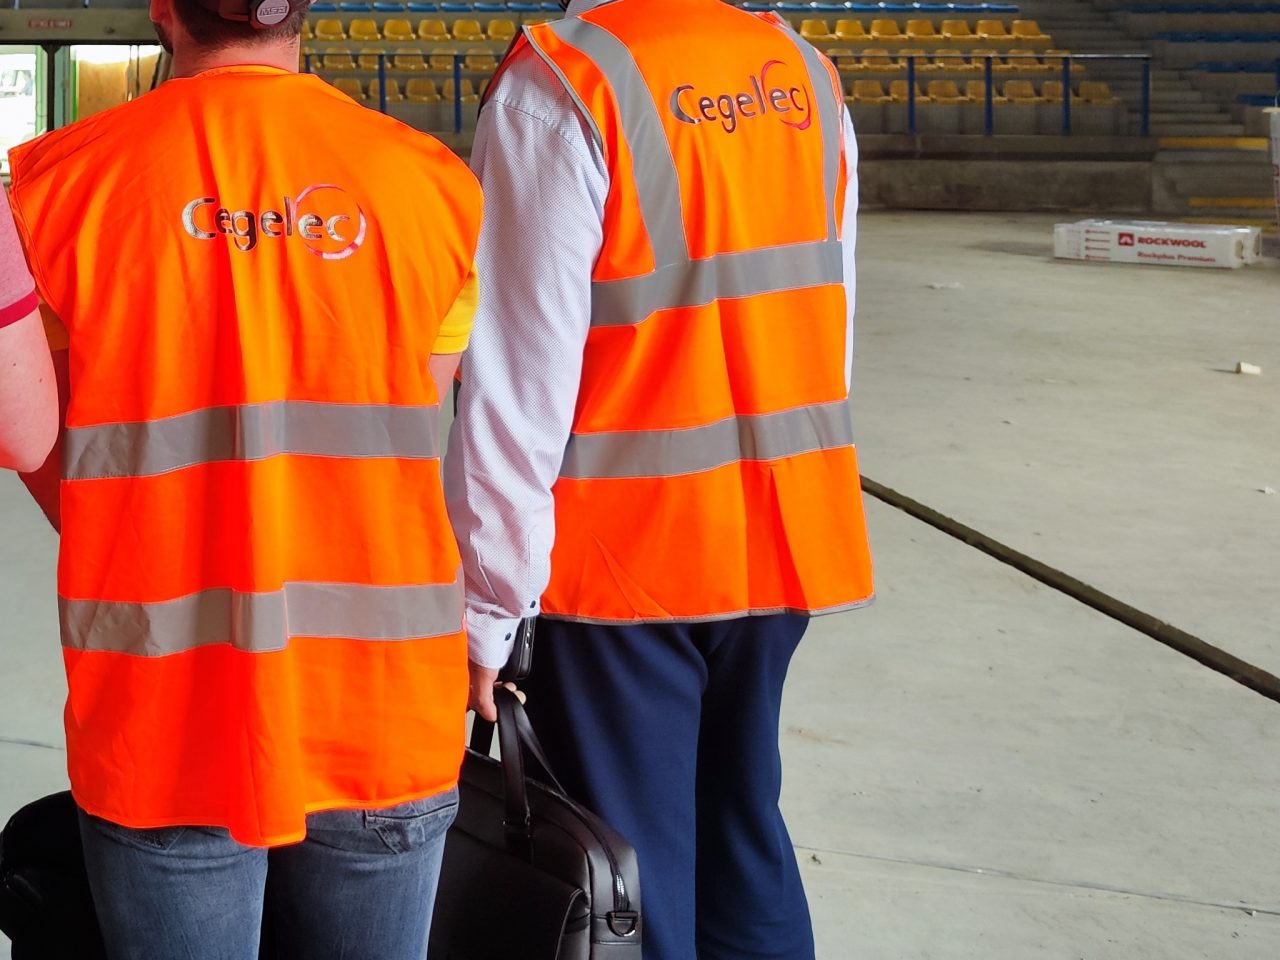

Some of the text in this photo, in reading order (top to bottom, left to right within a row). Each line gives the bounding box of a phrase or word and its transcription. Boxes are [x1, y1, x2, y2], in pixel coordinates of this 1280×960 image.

[260, 6, 286, 16] MSA
[669, 74, 805, 134] Cegelec
[181, 196, 350, 252] Cegelec
[1138, 236, 1206, 248] ROCKWOOL
[1177, 254, 1216, 262] Premium
